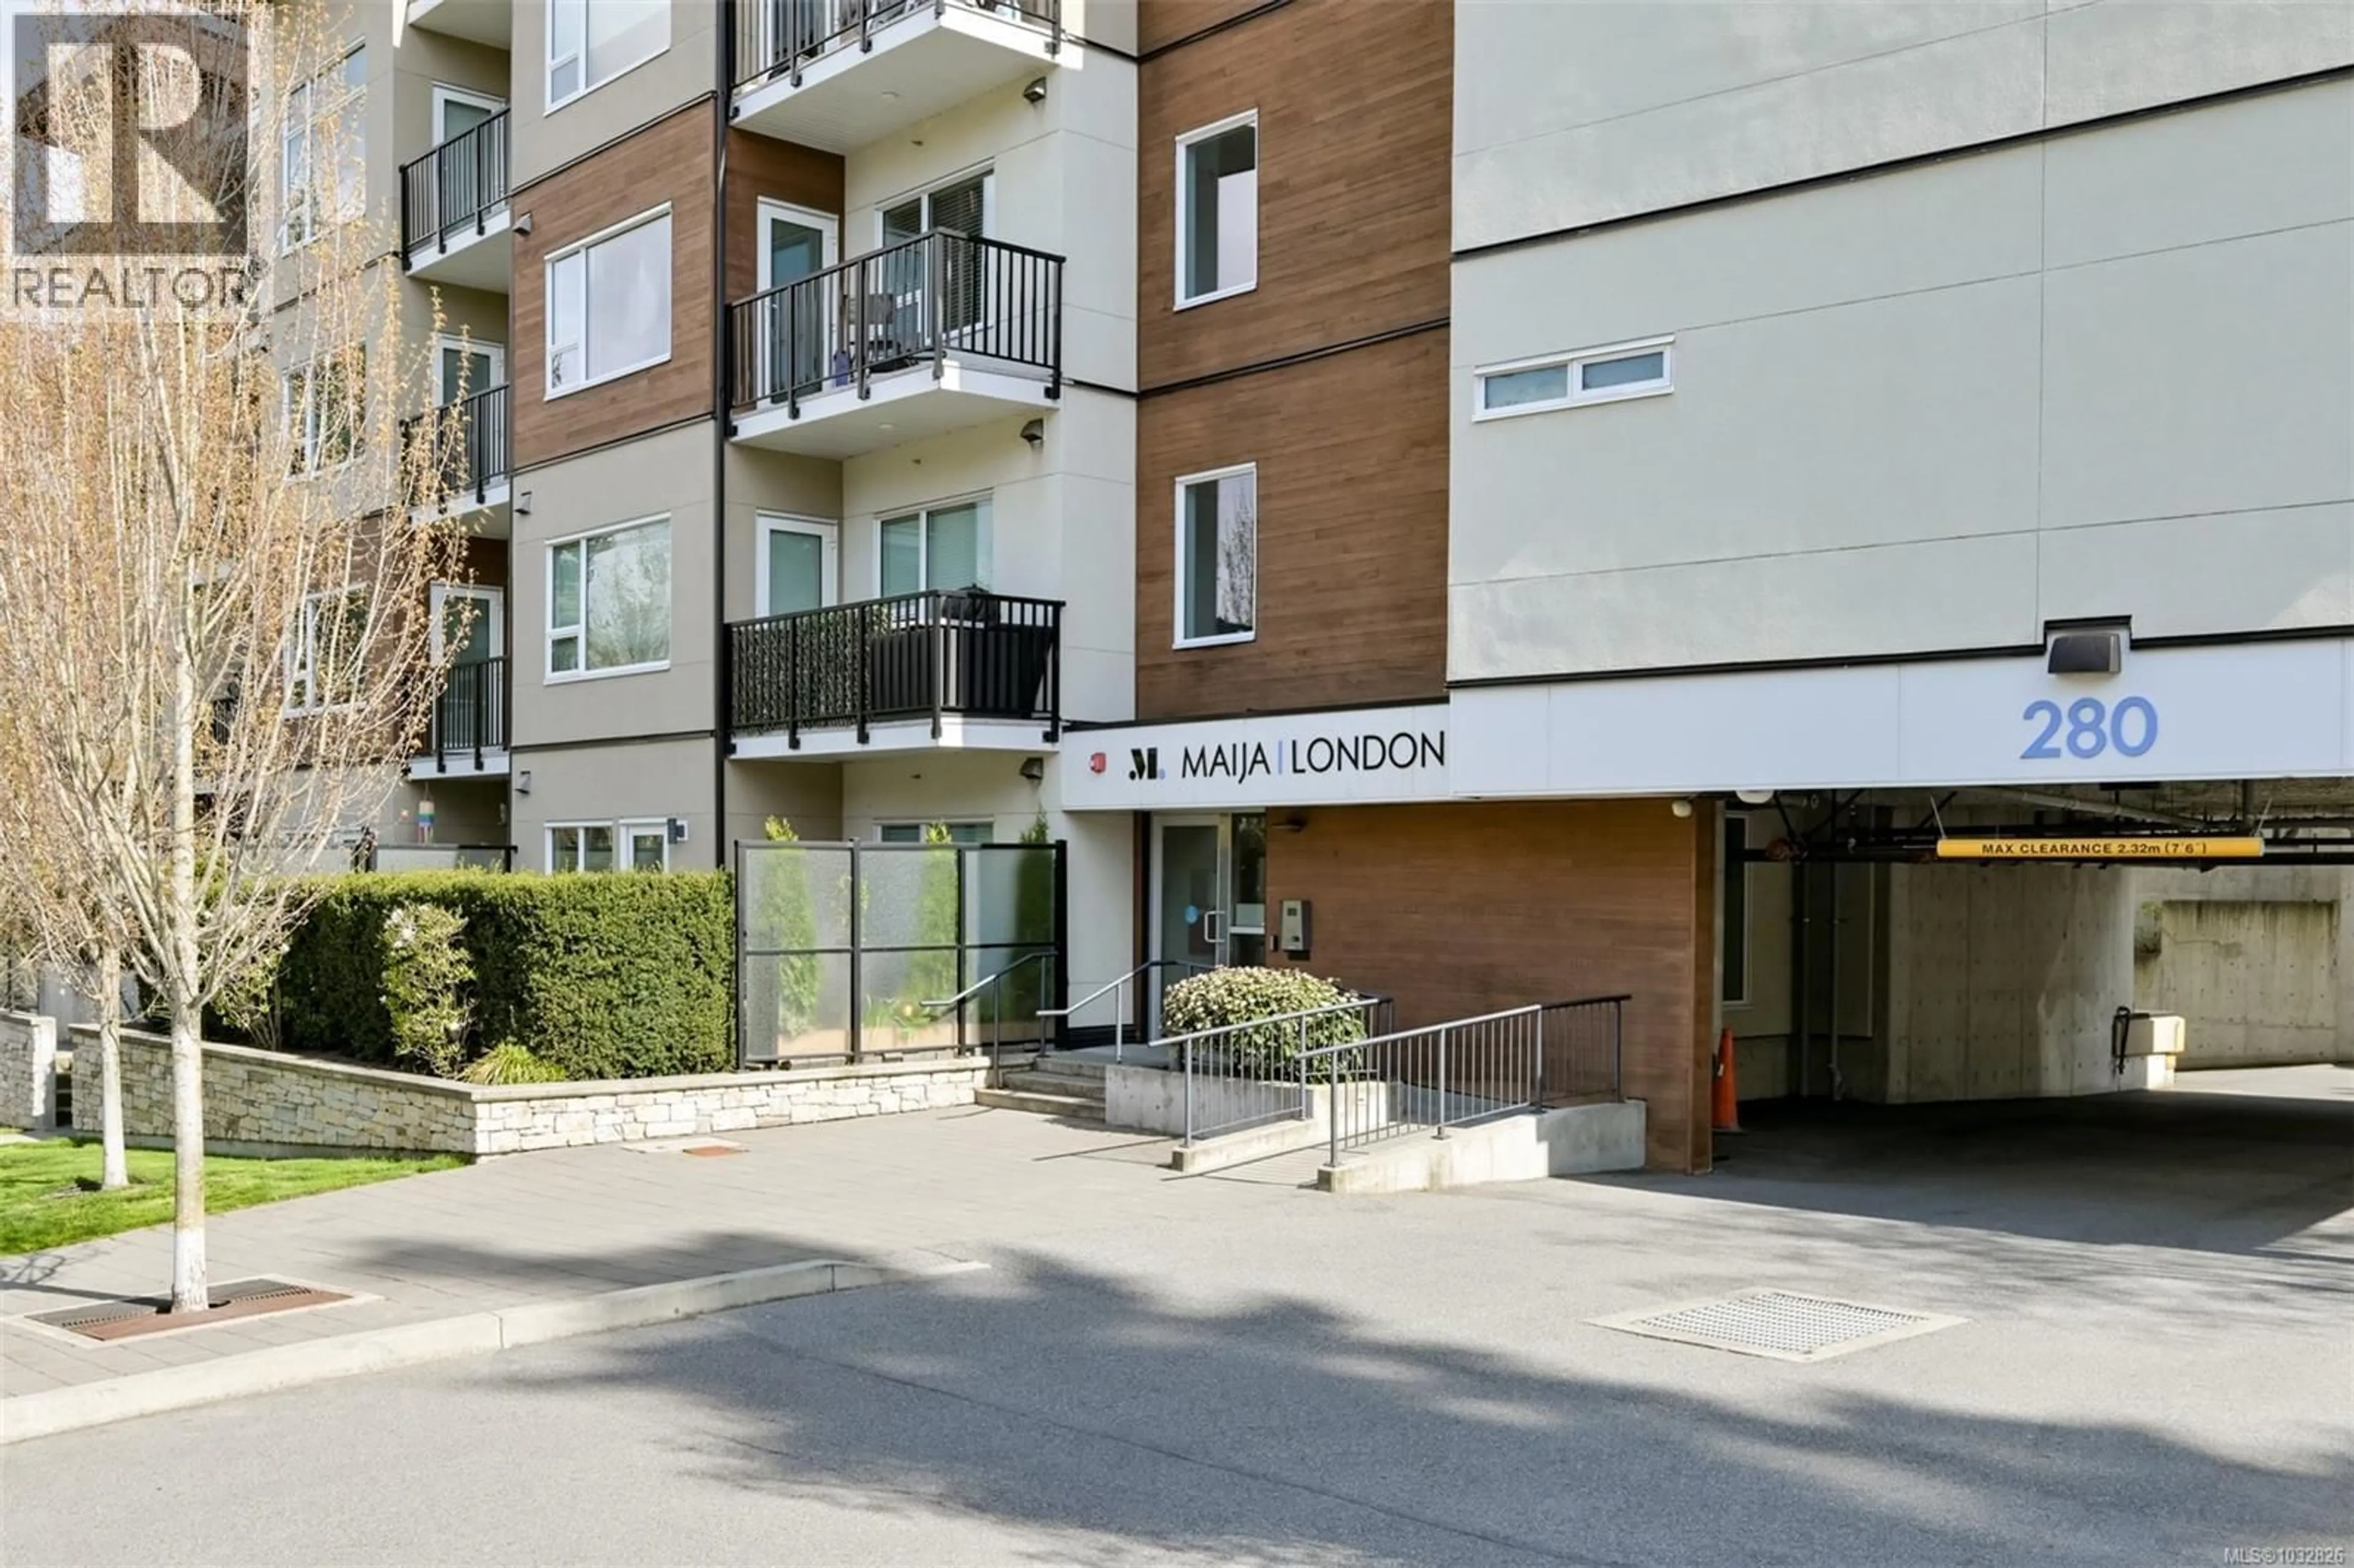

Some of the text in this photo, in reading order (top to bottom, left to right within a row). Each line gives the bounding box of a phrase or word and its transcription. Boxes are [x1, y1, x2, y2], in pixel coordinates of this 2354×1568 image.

[2019, 696, 2158, 759] 280
[1181, 731, 1445, 785] MAIJA LONDON
[1982, 843, 2014, 854] MAX
[2020, 843, 2112, 854] CLEARANCE
[2117, 843, 2160, 854] 2.32m
